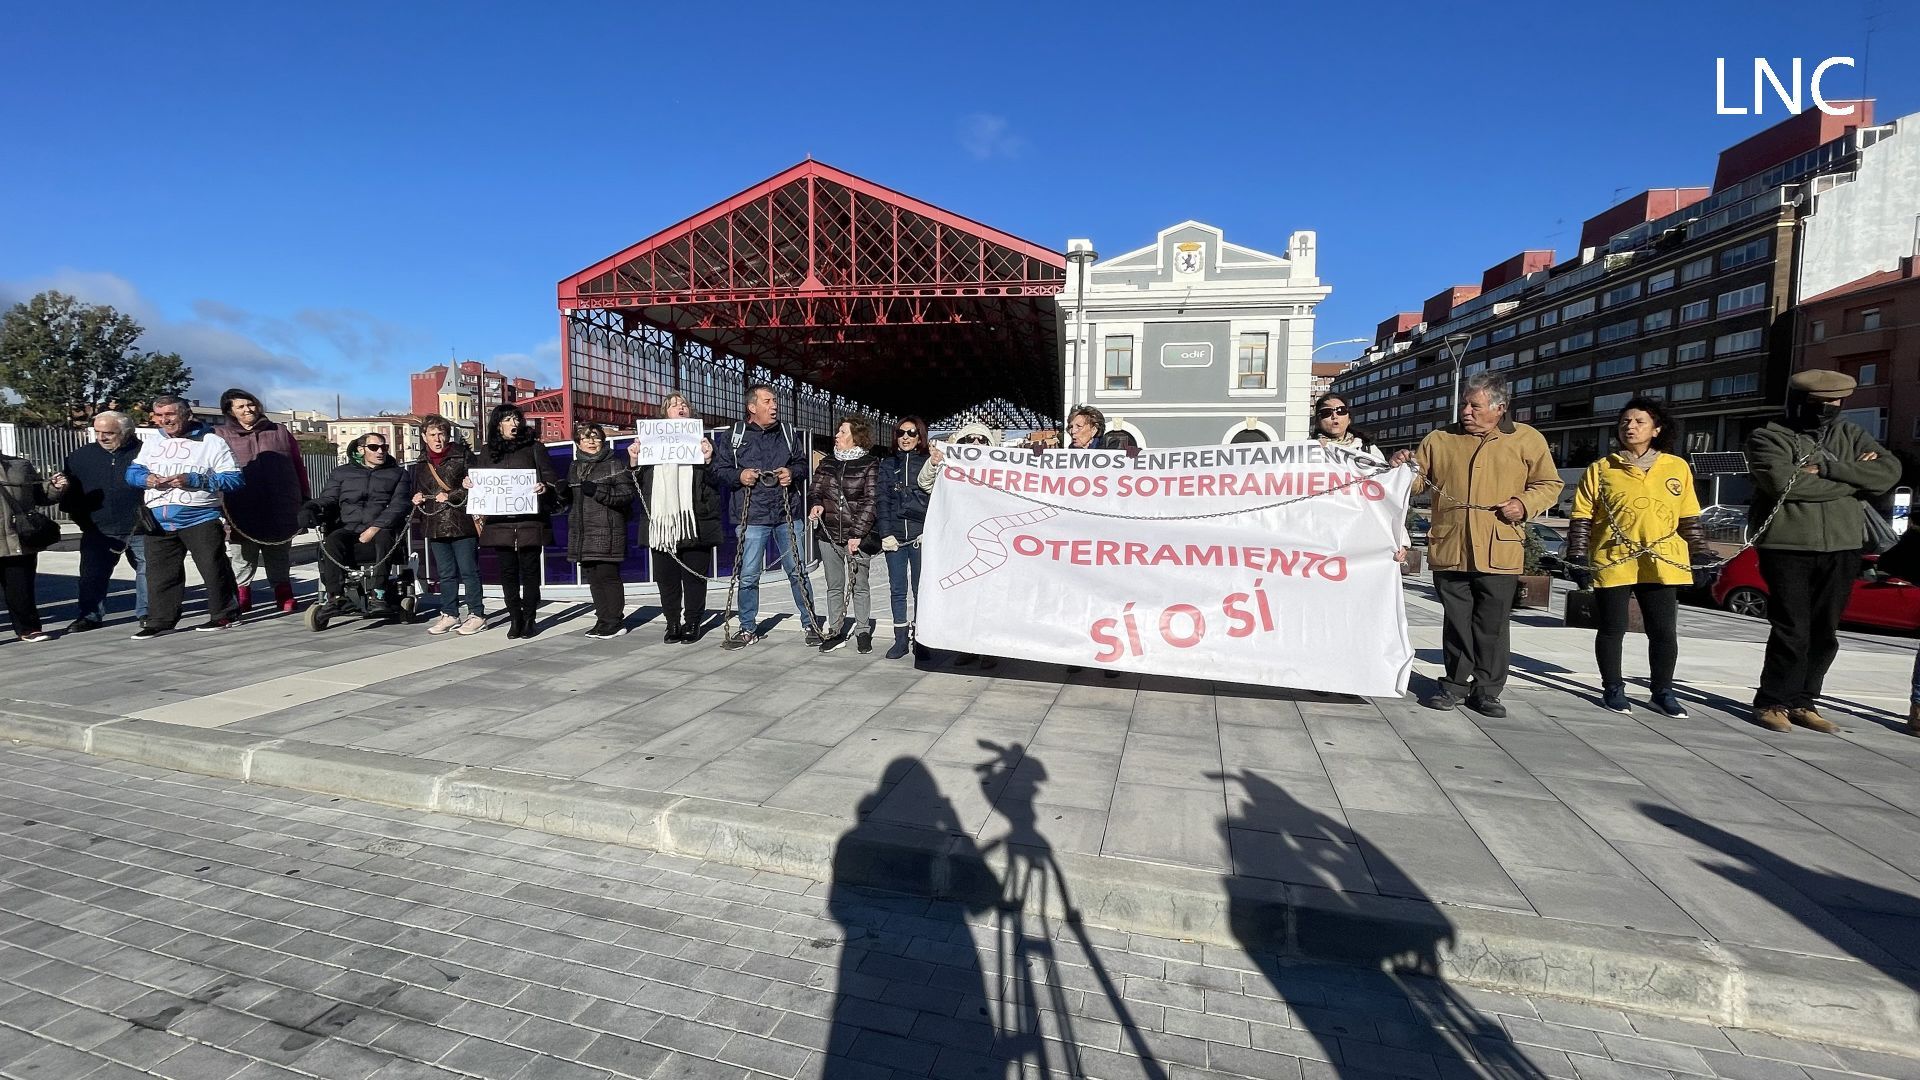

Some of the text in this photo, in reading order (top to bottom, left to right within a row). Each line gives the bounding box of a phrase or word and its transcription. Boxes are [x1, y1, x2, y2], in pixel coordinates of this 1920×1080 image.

[1180, 350, 1206, 359] adif
[639, 420, 702, 436] PUIGDEMONT
[657, 435, 680, 444] PIDE
[150, 440, 191, 460] SOS
[660, 443, 697, 460] LEÓN
[946, 445, 982, 461] NO
[989, 449, 1126, 470] QUEREMOS
[470, 471, 536, 486] PUIGDEMONT
[944, 465, 1108, 497] QUEREMOS
[484, 486, 513, 495] PIDE
[495, 492, 534, 513] LEÓN
[1012, 534, 1348, 582] OTERRAMIENTO
[1090, 578, 1274, 663] SÍ O SÍ
